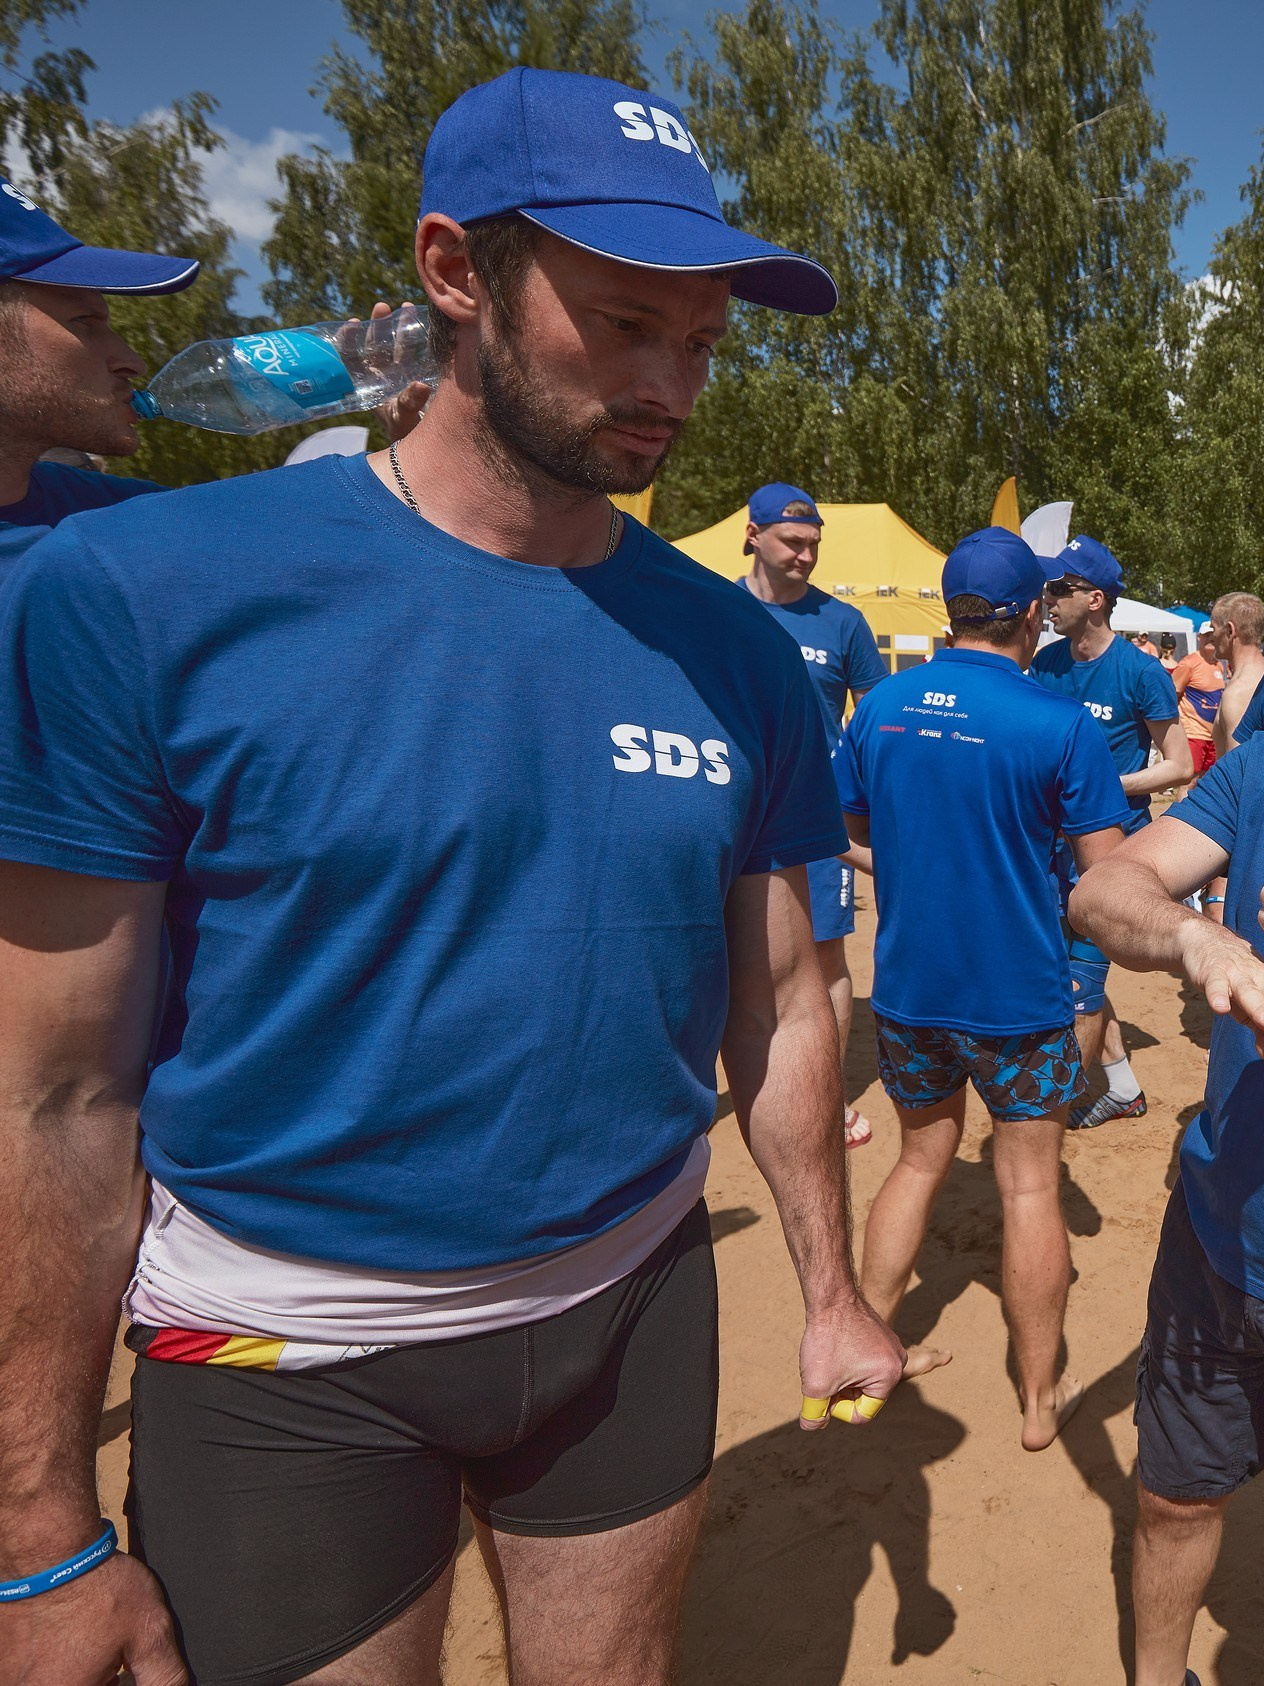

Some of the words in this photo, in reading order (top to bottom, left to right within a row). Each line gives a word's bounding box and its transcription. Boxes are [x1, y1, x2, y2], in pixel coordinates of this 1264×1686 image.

[613, 101, 710, 174] SD
[1, 183, 40, 210] S
[801, 646, 827, 665] DS
[923, 692, 956, 708] SDS
[920, 729, 942, 738] Kranz
[610, 723, 731, 785] SDS
